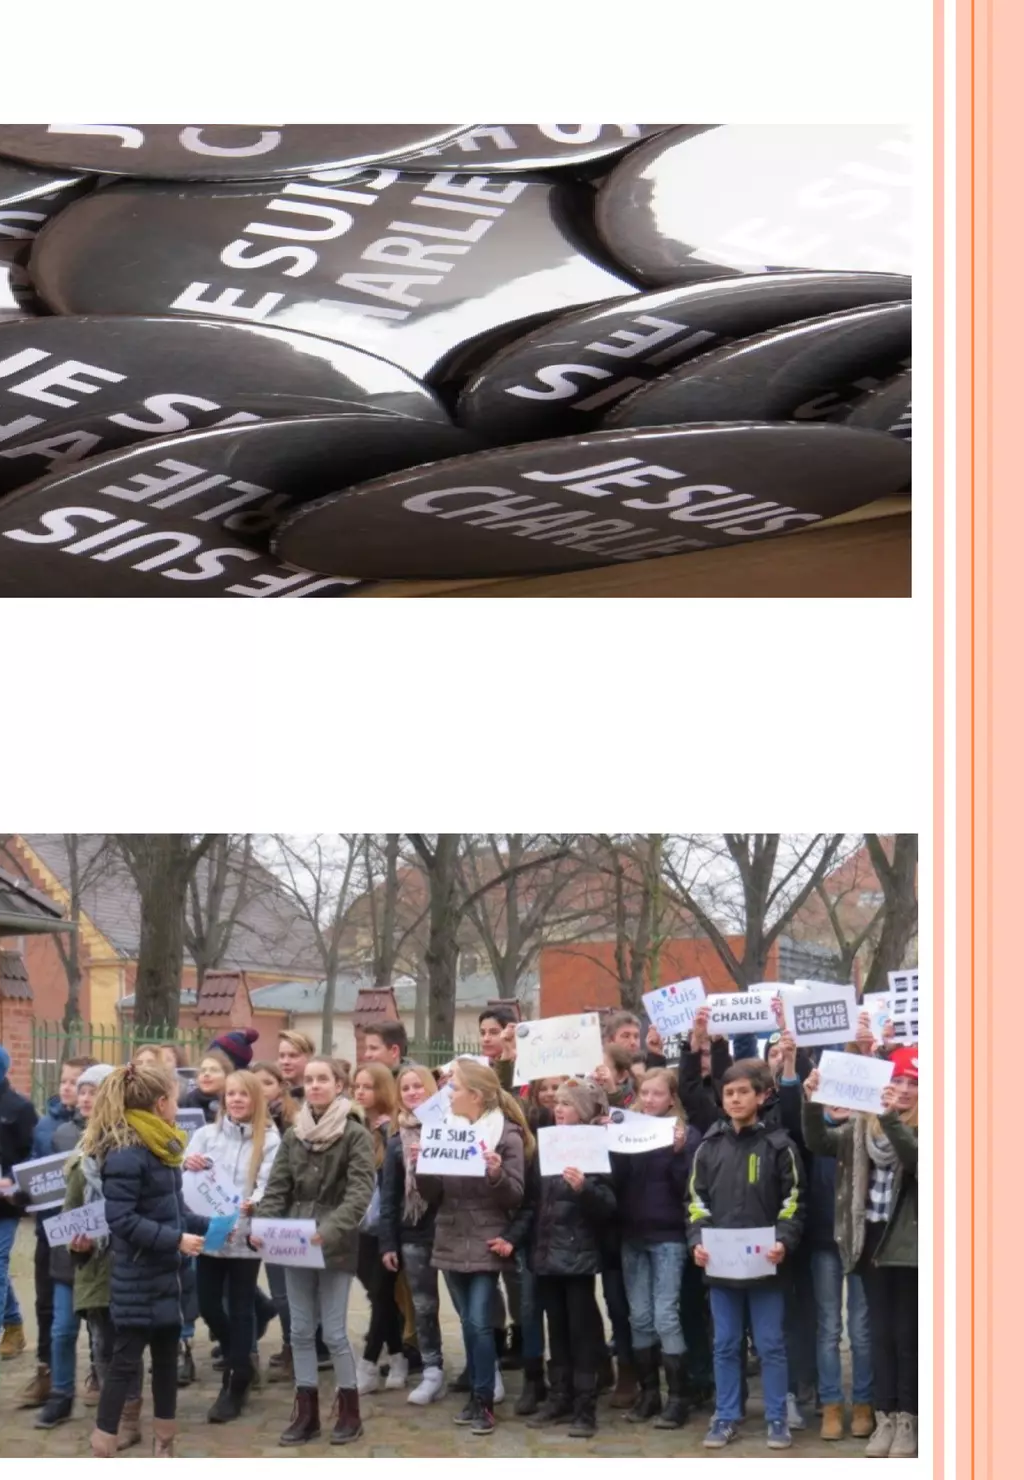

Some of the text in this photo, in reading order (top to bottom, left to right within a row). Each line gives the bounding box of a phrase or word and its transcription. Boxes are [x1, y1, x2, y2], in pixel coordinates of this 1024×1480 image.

[521, 457, 824, 536] JE SUIS
[2, 507, 261, 581] SUIS
[712, 995, 762, 1007] JE SUIS
[712, 1010, 769, 1023] CHARLIE
[796, 1003, 846, 1018] JE SUIS
[658, 1008, 697, 1031] Charli
[797, 1013, 848, 1032] CHARLIE
[426, 1128, 476, 1142] JE SUIS
[421, 1147, 471, 1160] CHARLIE
